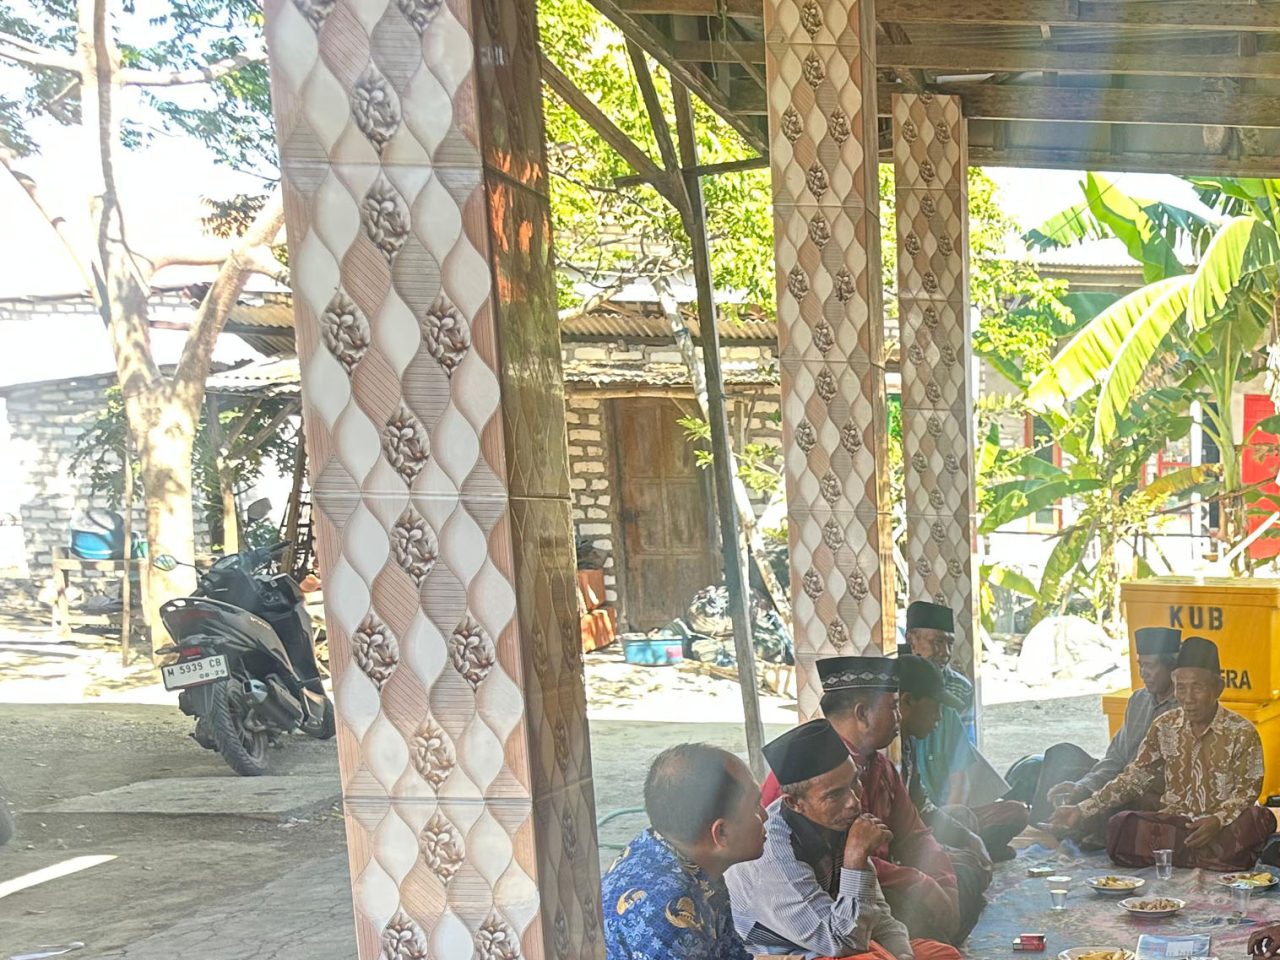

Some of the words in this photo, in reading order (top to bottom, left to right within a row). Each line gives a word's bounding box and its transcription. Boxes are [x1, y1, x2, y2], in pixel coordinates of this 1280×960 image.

[167, 668, 174, 677] M
[179, 662, 203, 674] 5939
[209, 658, 221, 668] CB
